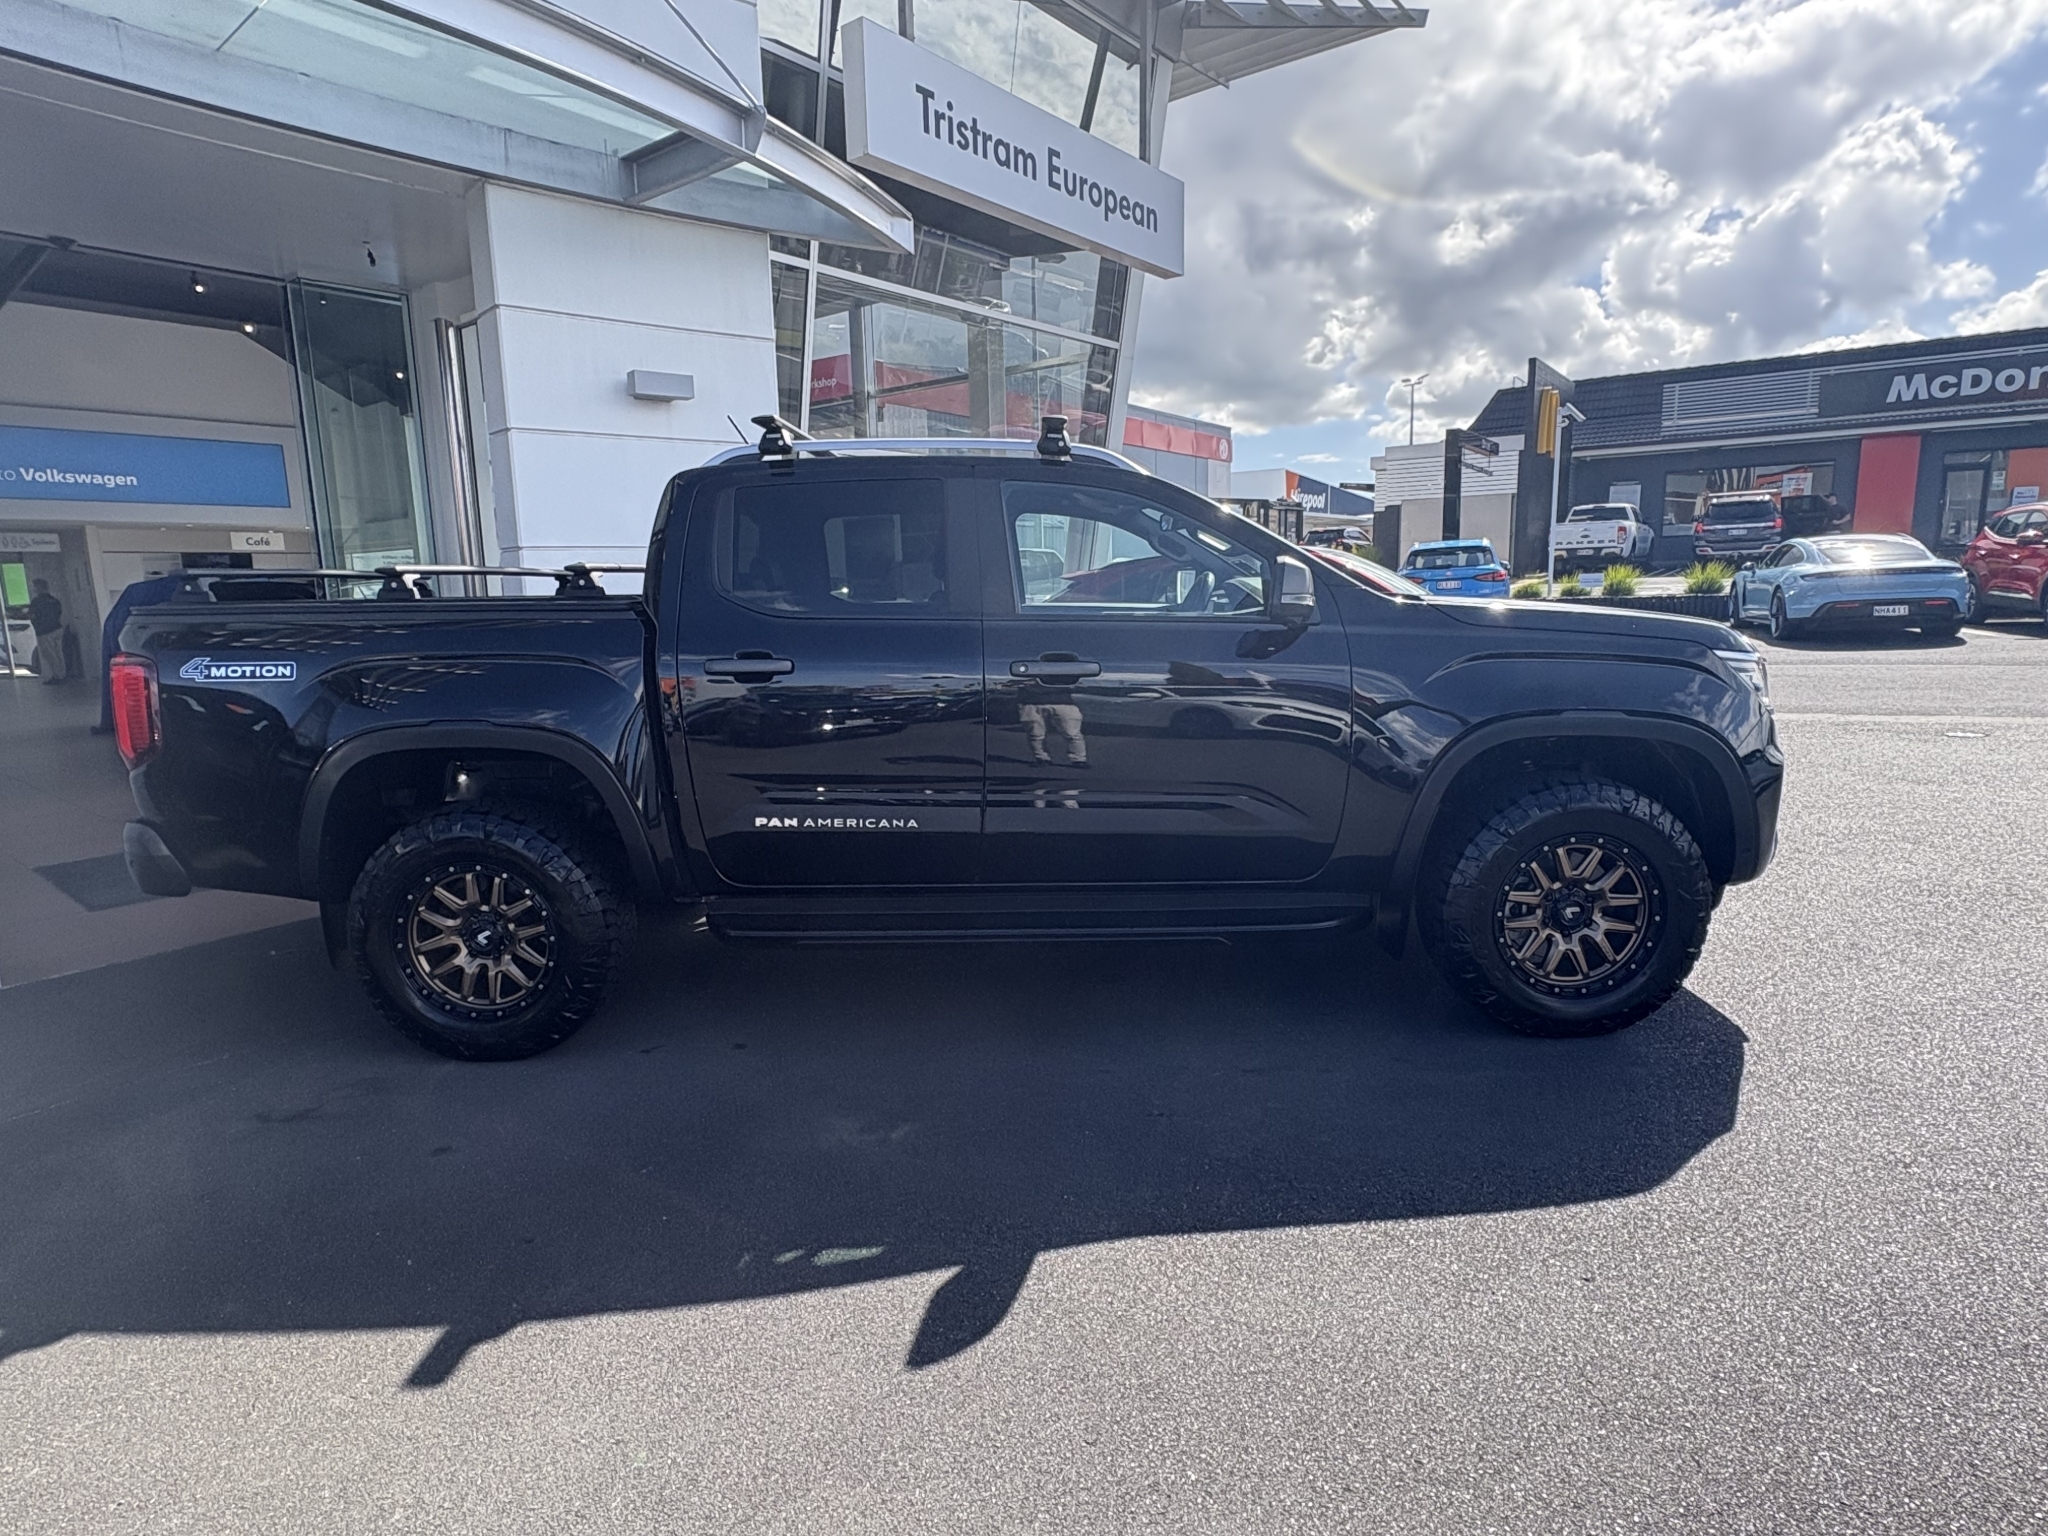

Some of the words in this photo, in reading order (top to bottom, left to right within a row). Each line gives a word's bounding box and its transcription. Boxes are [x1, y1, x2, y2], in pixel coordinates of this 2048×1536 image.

[915, 83, 1037, 181] Tristram
[1047, 146, 1158, 233] European
[1886, 366, 2048, 403] McDon
[19, 467, 138, 488] Volkswagen
[1291, 487, 1325, 512] Hirepool
[246, 536, 271, 546] Café
[1874, 606, 1907, 615] NHA411
[180, 657, 292, 680] 4MOTION
[755, 817, 798, 828] PAN
[803, 818, 919, 828] AMERICANA
